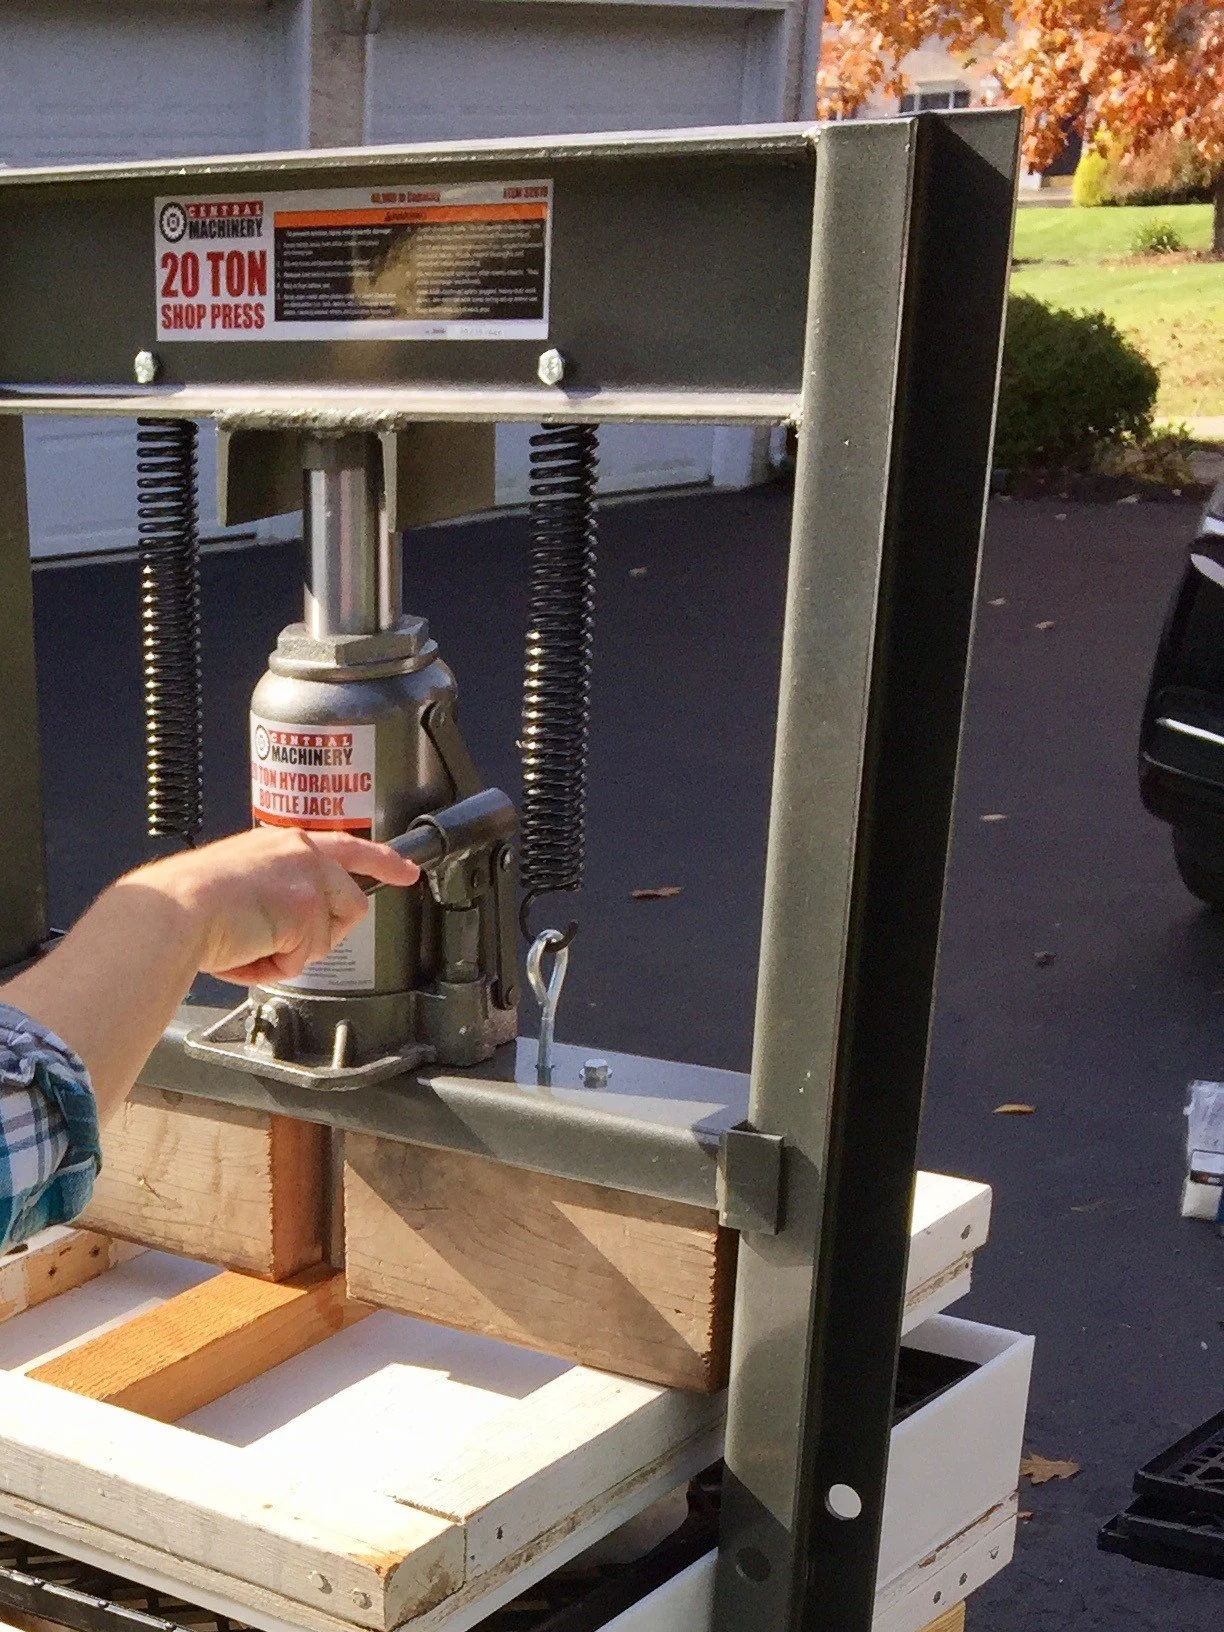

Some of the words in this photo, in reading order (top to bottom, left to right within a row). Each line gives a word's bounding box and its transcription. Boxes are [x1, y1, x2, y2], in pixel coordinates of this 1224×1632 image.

[188, 203, 262, 217] CENTRAL
[189, 218, 263, 239] MACHINERY
[161, 252, 199, 297] 20
[206, 250, 267, 297] TON
[161, 303, 206, 330] SHOP
[211, 302, 265, 329] PRESS
[271, 731, 352, 747] CENTRAL
[271, 746, 353, 766] MACHINERY
[259, 765, 276, 788] TON
[279, 771, 372, 793] HYDRAULIC
[259, 788, 300, 814] BOTTLE
[301, 796, 345, 816] JACK
